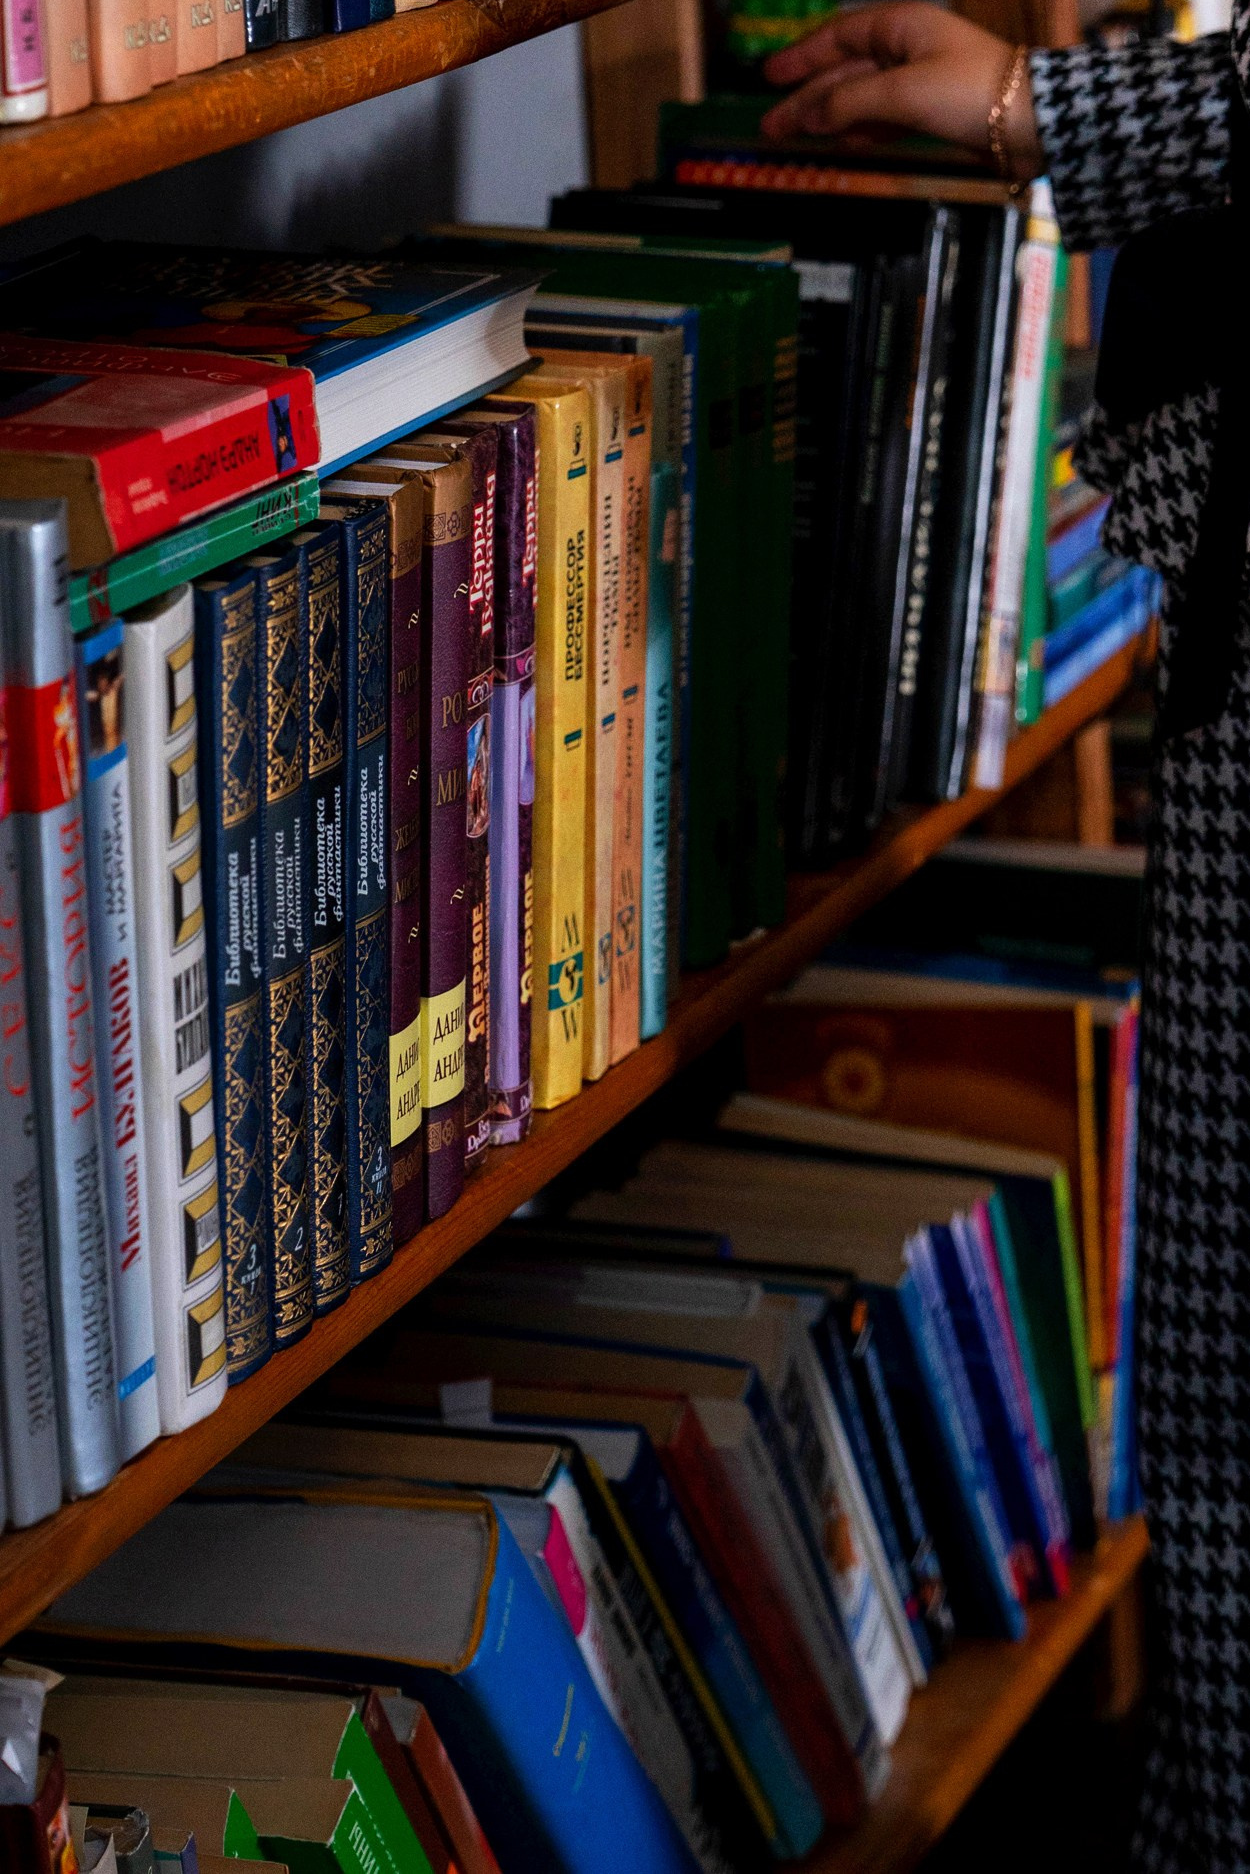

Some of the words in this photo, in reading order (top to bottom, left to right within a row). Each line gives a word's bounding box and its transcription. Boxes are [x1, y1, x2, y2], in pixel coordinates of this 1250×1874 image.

[469, 502, 484, 614] Терри
[479, 471, 496, 635] Гудкайнд
[521, 476, 535, 584] Терри
[565, 537, 577, 681] ПРОФЕССОР
[574, 528, 586, 680] БЕССМЕРТИЯ
[292, 815, 303, 953] фантастики
[314, 796, 327, 926] Библиотека
[324, 822, 335, 897] русской
[331, 784, 343, 921] фантастики
[357, 766, 369, 895] Библиотека
[368, 789, 378, 863] русской
[376, 753, 386, 889] фантастики
[224, 851, 241, 986] Библиотека
[240, 872, 252, 951] русской
[250, 836, 262, 979] фантастики
[272, 829, 286, 959] Библиотека
[285, 855, 296, 928] русской
[107, 957, 137, 1150] БУЛГАКОВ
[120, 1152, 142, 1272] Михаил
[338, 1193, 344, 1216] 1
[375, 1146, 383, 1172] 3
[247, 1243, 257, 1270] 3
[294, 1226, 304, 1251] 2
